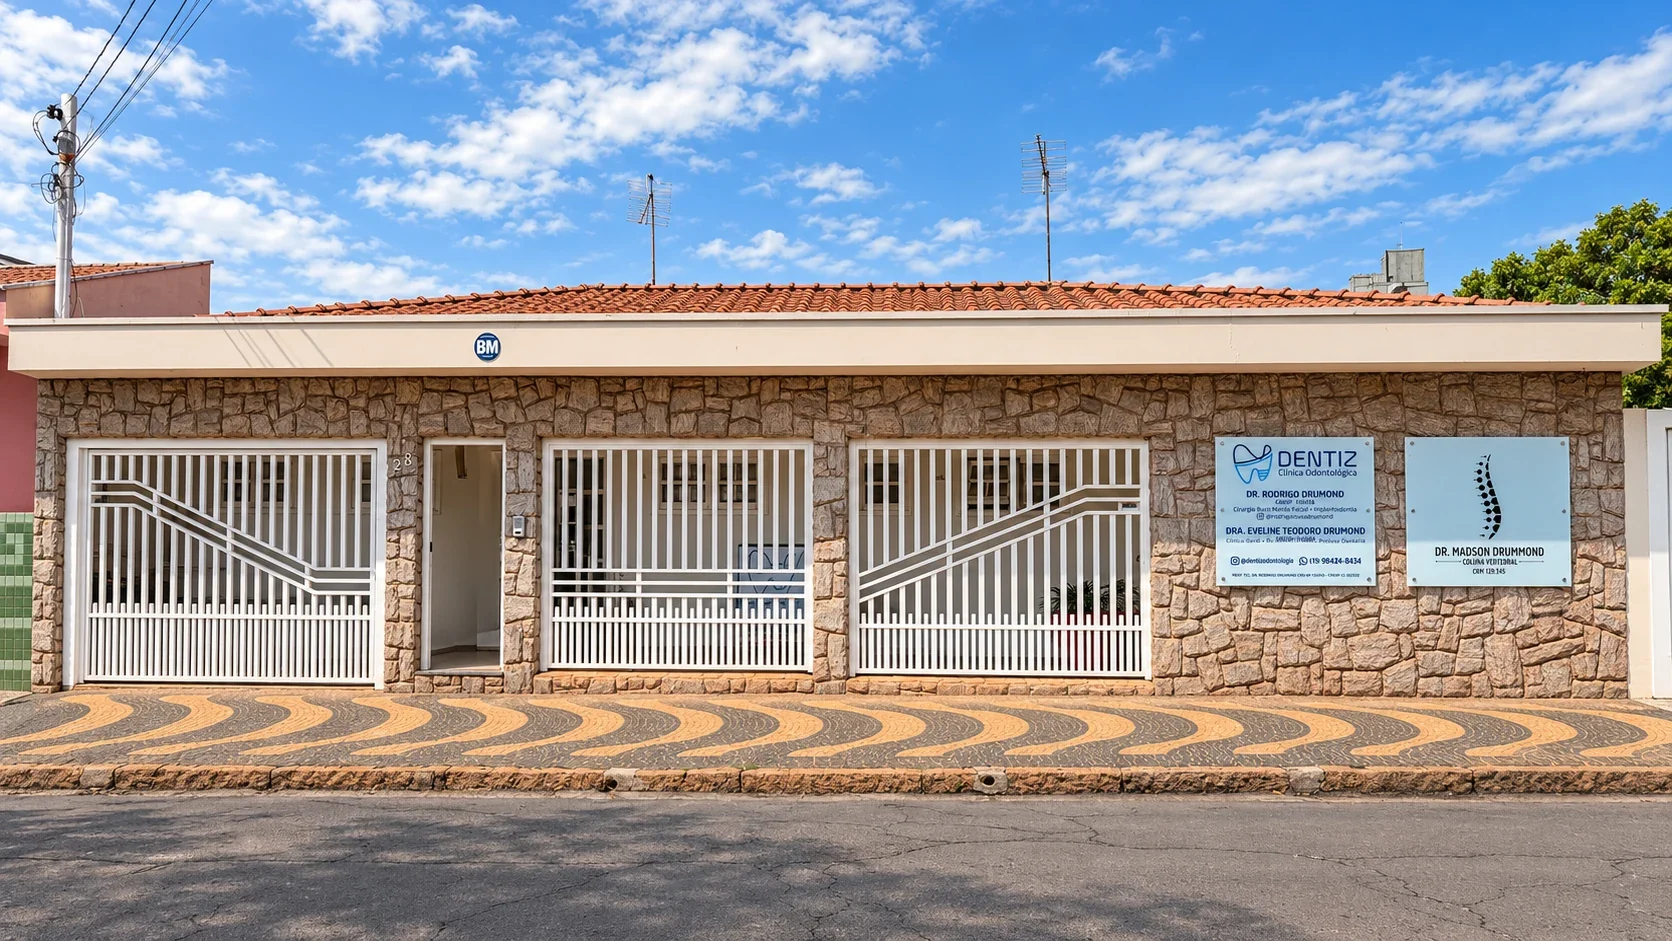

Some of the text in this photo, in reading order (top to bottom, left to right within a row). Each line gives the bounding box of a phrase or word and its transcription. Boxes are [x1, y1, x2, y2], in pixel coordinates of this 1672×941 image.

[476, 339, 499, 355] BM
[1278, 450, 1357, 467] DENTIZ
[1246, 490, 1345, 498] DR. RODRIGO DRUMOND
[1225, 527, 1366, 535] DRA. EVELINE TEODORO DRUMOND
[1435, 546, 1545, 557] DR. MADSON DRUMMOND
